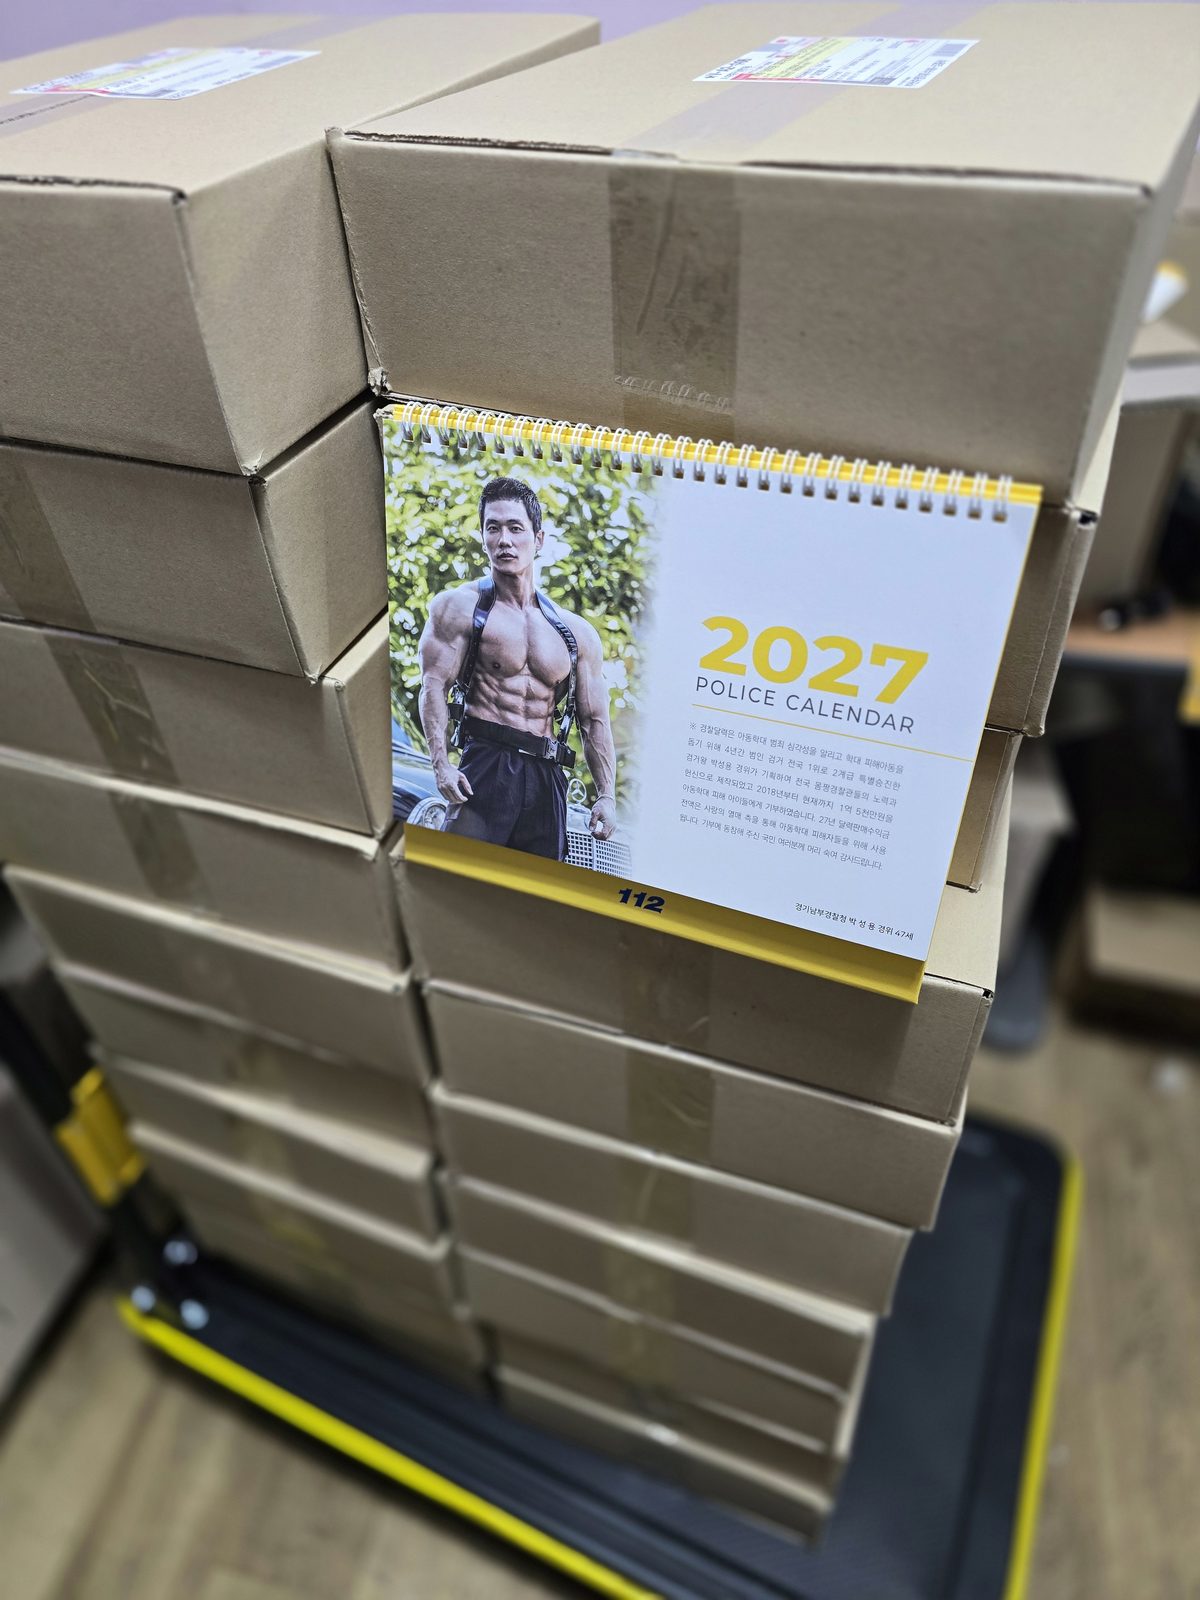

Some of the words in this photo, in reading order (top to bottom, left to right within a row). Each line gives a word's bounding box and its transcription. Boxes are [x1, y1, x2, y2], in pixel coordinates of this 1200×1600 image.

[699, 615, 929, 705] 2027
[696, 676, 776, 707] POLICE
[786, 694, 915, 734] CALENDAR
[699, 723, 735, 739] 경찰달력은
[737, 731, 768, 746] 아동학대
[769, 738, 785, 750] 범죄
[787, 742, 817, 756] 심각성을
[819, 748, 843, 761] 알리고
[845, 753, 862, 765] 학대
[864, 758, 904, 775] 피해아동을
[706, 741, 722, 753] 위해
[724, 745, 746, 758] 4년간
[748, 750, 765, 762] 범인
[768, 754, 784, 766] 검거
[787, 758, 804, 770] 전국
[808, 763, 828, 775] 1위로
[831, 768, 855, 782] 2계급
[684, 768, 714, 782] 헌신으로
[716, 775, 754, 792] 제작되었고
[756, 784, 799, 803] 2018년부터
[802, 795, 834, 810] 현재까지
[839, 804, 853, 815] 1억
[855, 807, 894, 824] 5천만원을
[686, 752, 708, 766] 검거왕
[710, 759, 732, 771] 박성용
[736, 763, 758, 777] 경위가
[795, 777, 811, 789] 전국
[872, 794, 897, 808] 노력과
[680, 798, 702, 811] 전액은
[703, 804, 725, 817] 사랑의
[778, 822, 809, 837] 아동학대
[811, 829, 850, 847] 피해자들을
[852, 839, 869, 851] 위해
[870, 844, 887, 856] 사용
[682, 783, 710, 798] 아동학대
[711, 790, 726, 801] 피해
[727, 794, 763, 810] 아이들에게
[818, 815, 836, 827] 27년
[838, 819, 890, 840] 달력판매수익금
[701, 819, 722, 831] 기부에
[745, 829, 761, 841] 주신
[761, 833, 776, 845] 국민
[777, 837, 806, 852] 여러분께
[806, 844, 822, 856] 머리
[618, 888, 665, 913] 112
[795, 902, 847, 923] 경기남부경찰청
[849, 916, 857, 926] 박
[859, 919, 867, 928] 성
[868, 922, 876, 931] 용
[878, 924, 893, 936] 경위
[895, 929, 914, 941] 47세
